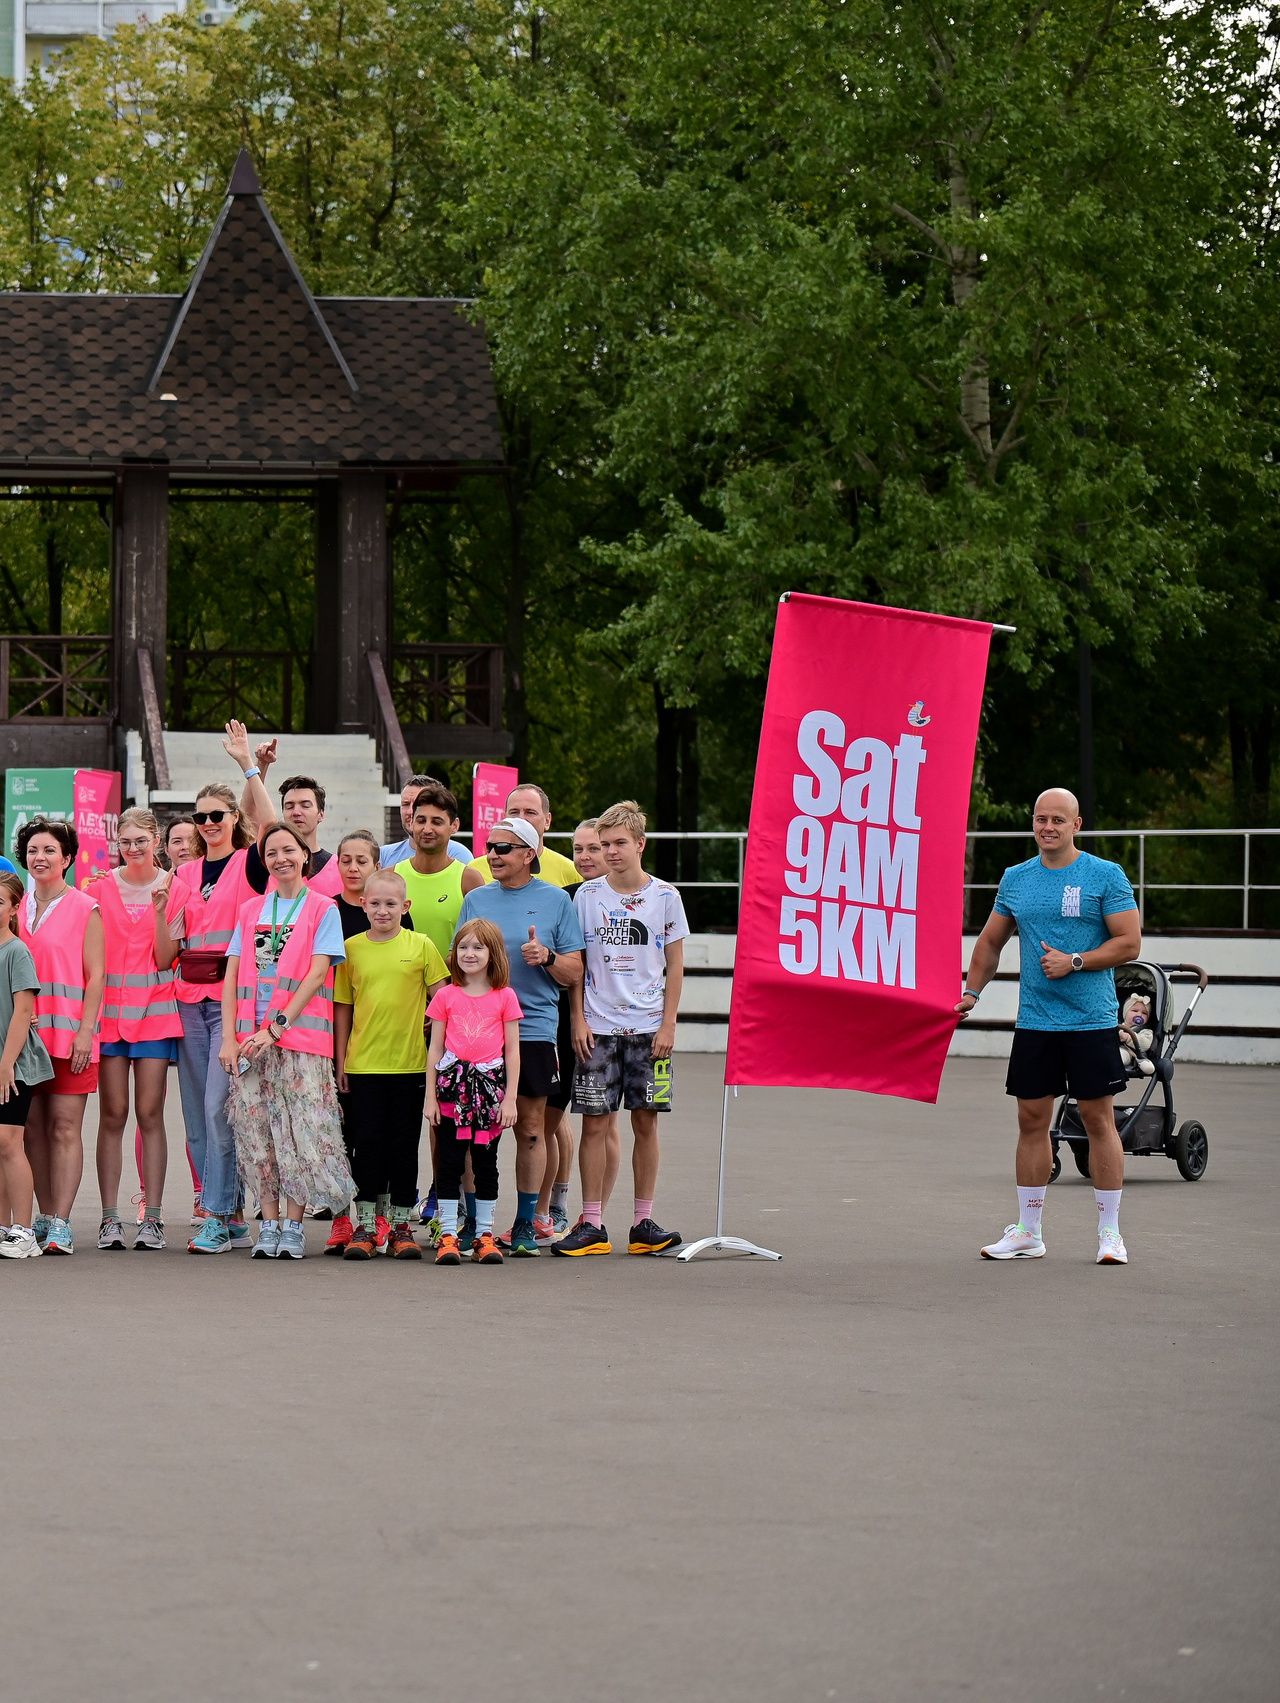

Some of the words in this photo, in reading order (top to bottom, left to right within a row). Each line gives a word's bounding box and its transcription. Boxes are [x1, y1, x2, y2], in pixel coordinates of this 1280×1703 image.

[793, 710, 927, 830] Sat
[784, 815, 920, 911] 9AM
[1063, 885, 1082, 897] Sat
[1062, 896, 1081, 907] 9AM
[1061, 906, 1081, 917] 5KM
[608, 918, 629, 928] THE
[595, 927, 629, 936] NORTH
[601, 936, 629, 946] FACE
[778, 895, 917, 990] 5KM
